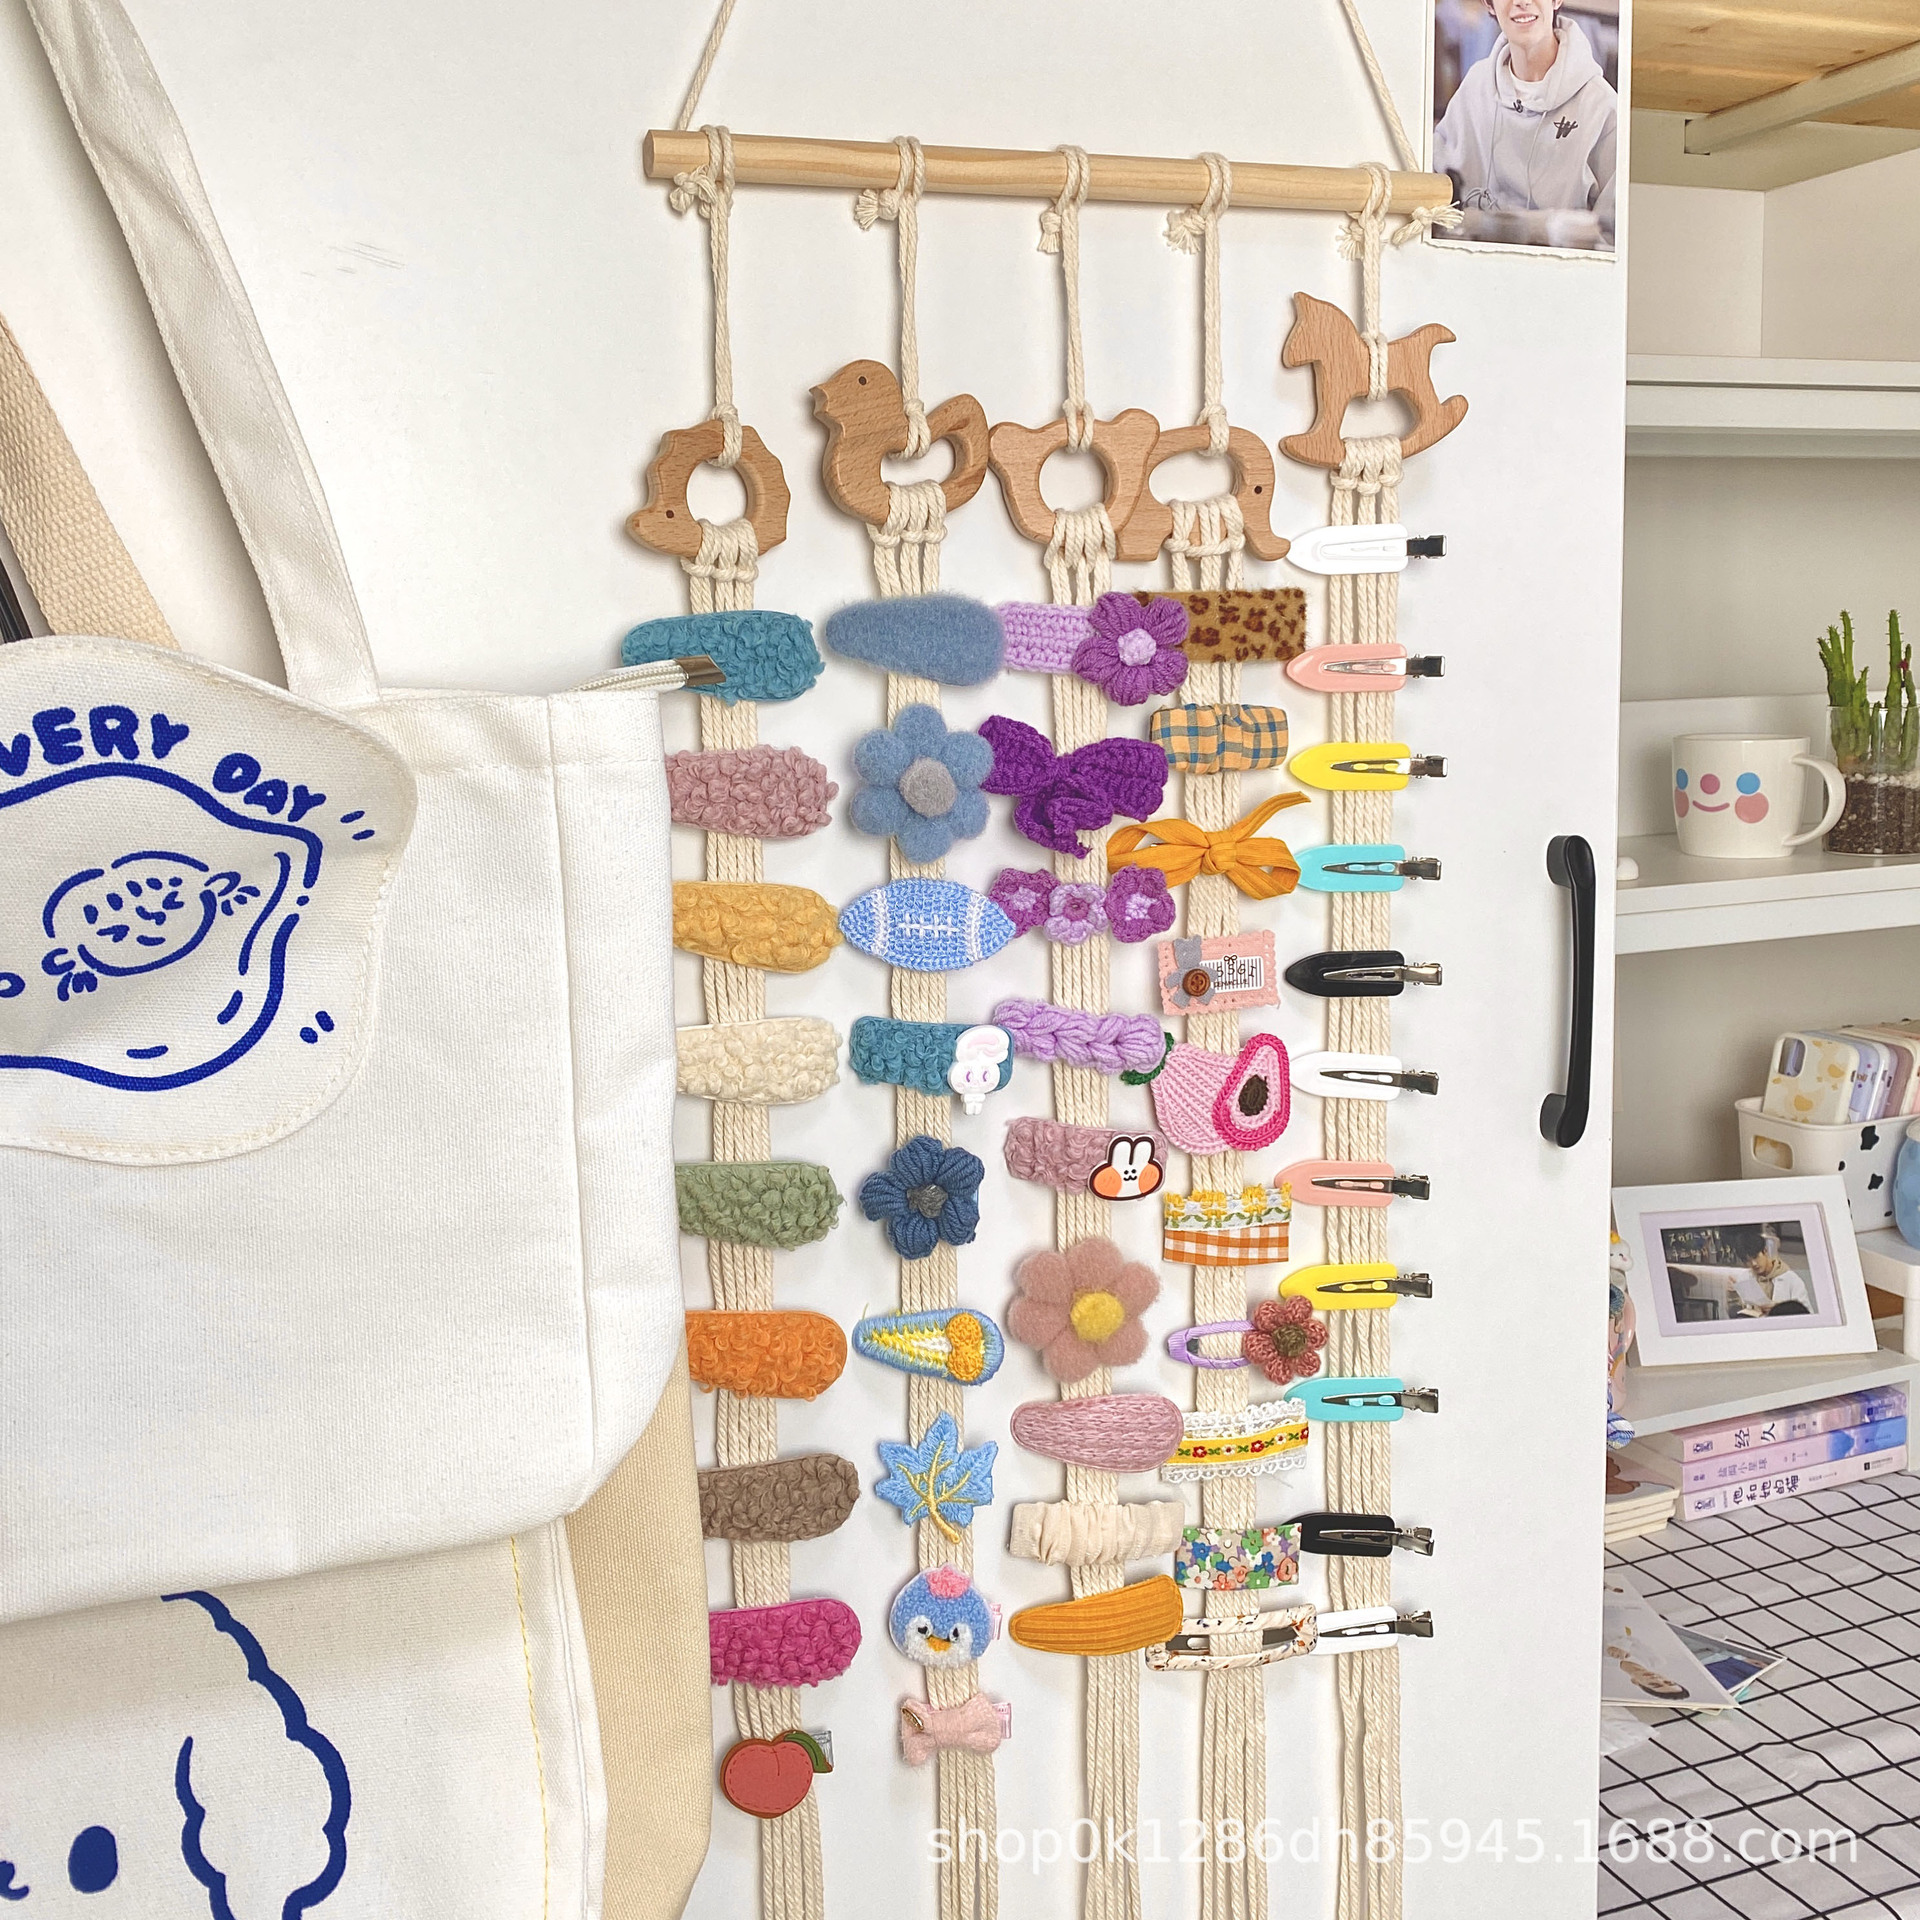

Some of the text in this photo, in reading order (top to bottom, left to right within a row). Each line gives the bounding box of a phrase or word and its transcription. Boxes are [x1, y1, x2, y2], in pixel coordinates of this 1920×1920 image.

[212, 752, 327, 822] DAY
[1732, 1475, 1800, 1505] 他和她的猫
